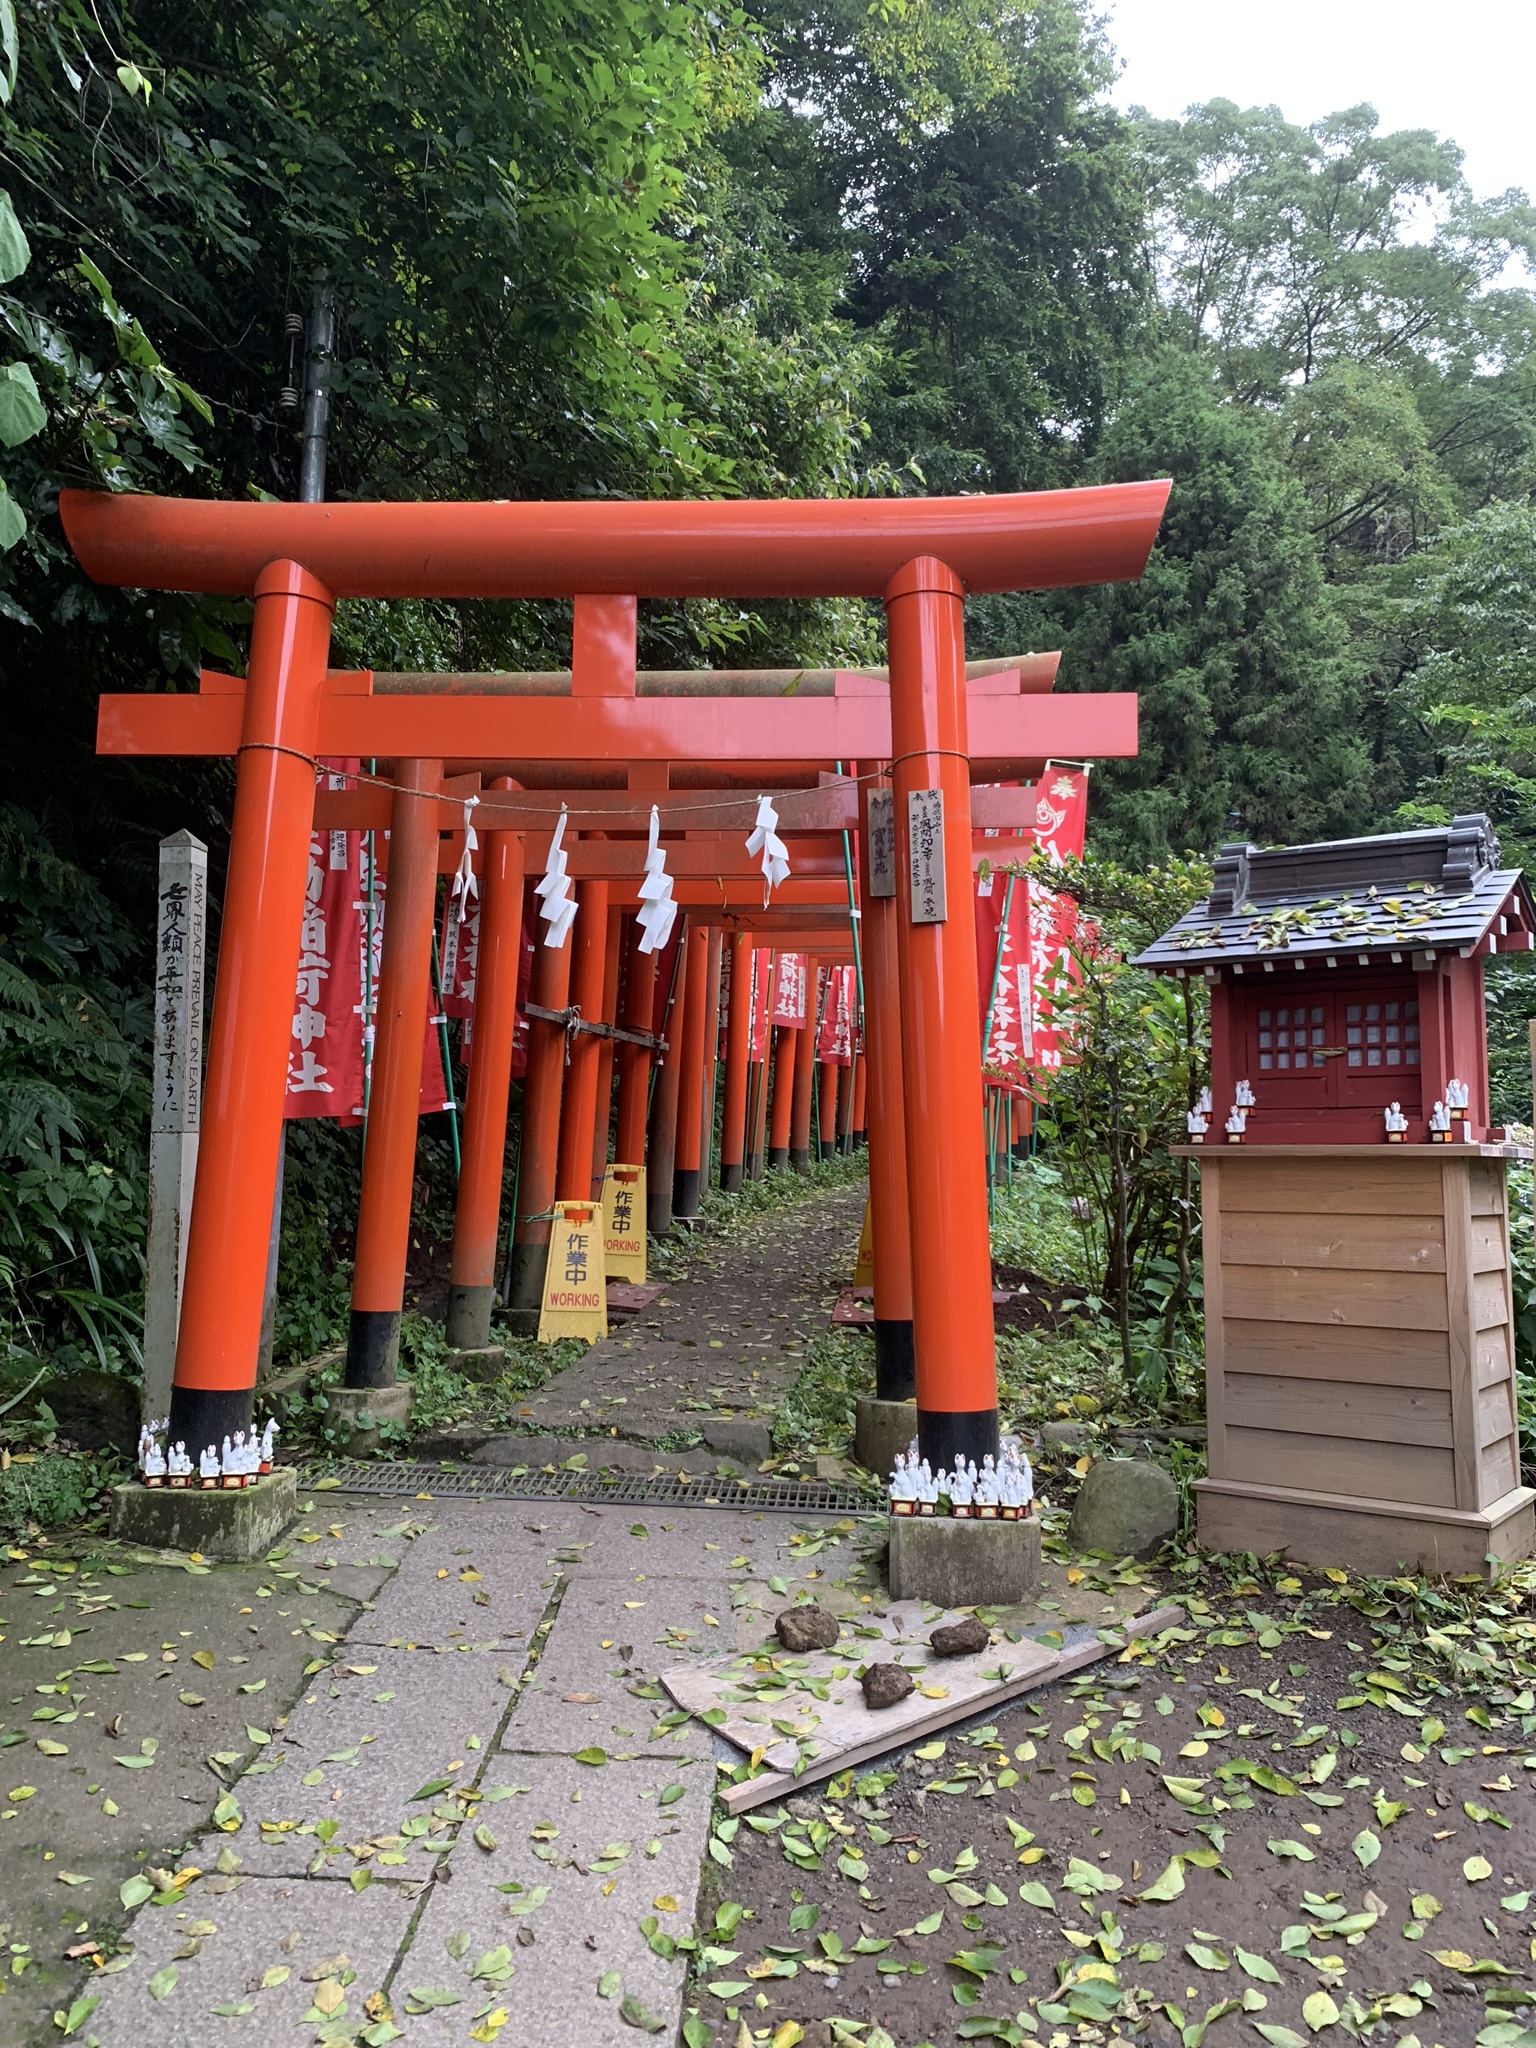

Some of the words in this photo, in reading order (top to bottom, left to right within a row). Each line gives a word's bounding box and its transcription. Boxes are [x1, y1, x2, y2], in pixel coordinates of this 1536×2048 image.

[193, 873, 204, 911] MAY
[192, 913, 204, 967] PEACE
[158, 882, 189, 1113] 世界人類が平和でありますように
[190, 969, 203, 1035] PREVAIL
[190, 1037, 200, 1064] ON
[186, 1066, 201, 1126] EARTH
[612, 1191, 633, 1233] 作業中
[565, 1234, 588, 1286] 作業中
[550, 1293, 600, 1307] WORKING
